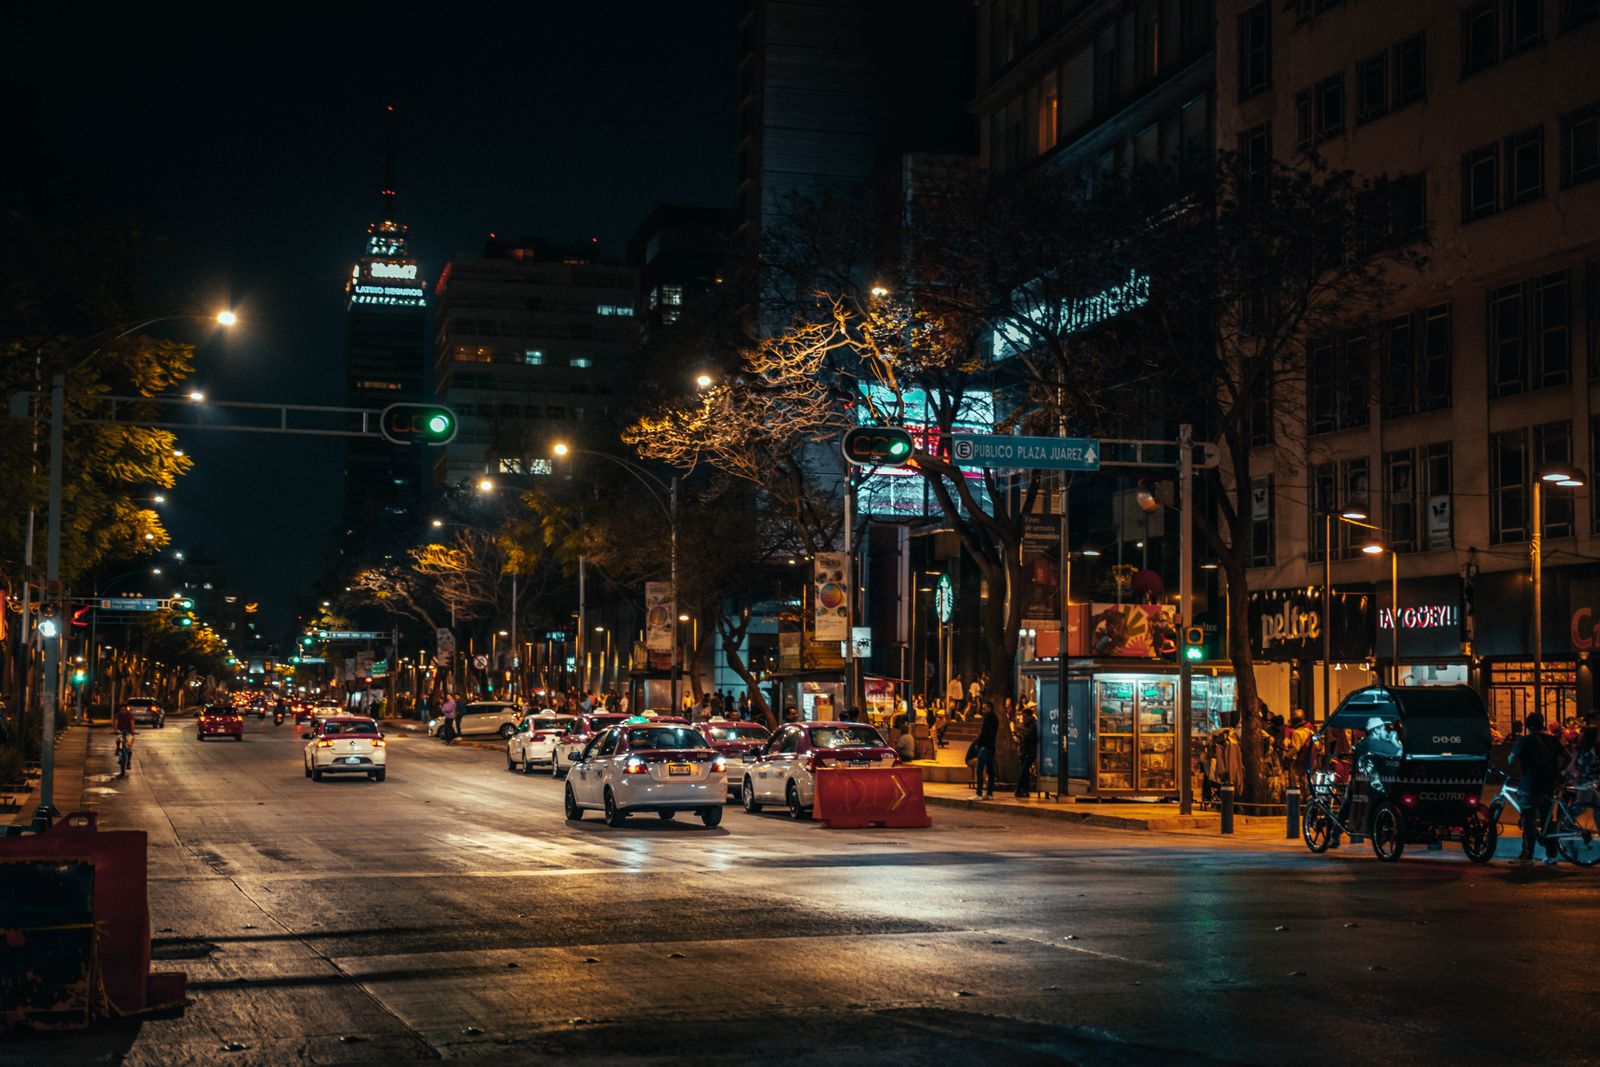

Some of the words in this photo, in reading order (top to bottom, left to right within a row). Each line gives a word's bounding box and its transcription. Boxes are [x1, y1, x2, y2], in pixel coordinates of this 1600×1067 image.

[385, 287, 423, 296] SEGUROS
[1017, 446, 1047, 459] PLAZA
[1261, 600, 1320, 648] peltre
[1419, 791, 1466, 801] CICLOTAXI
